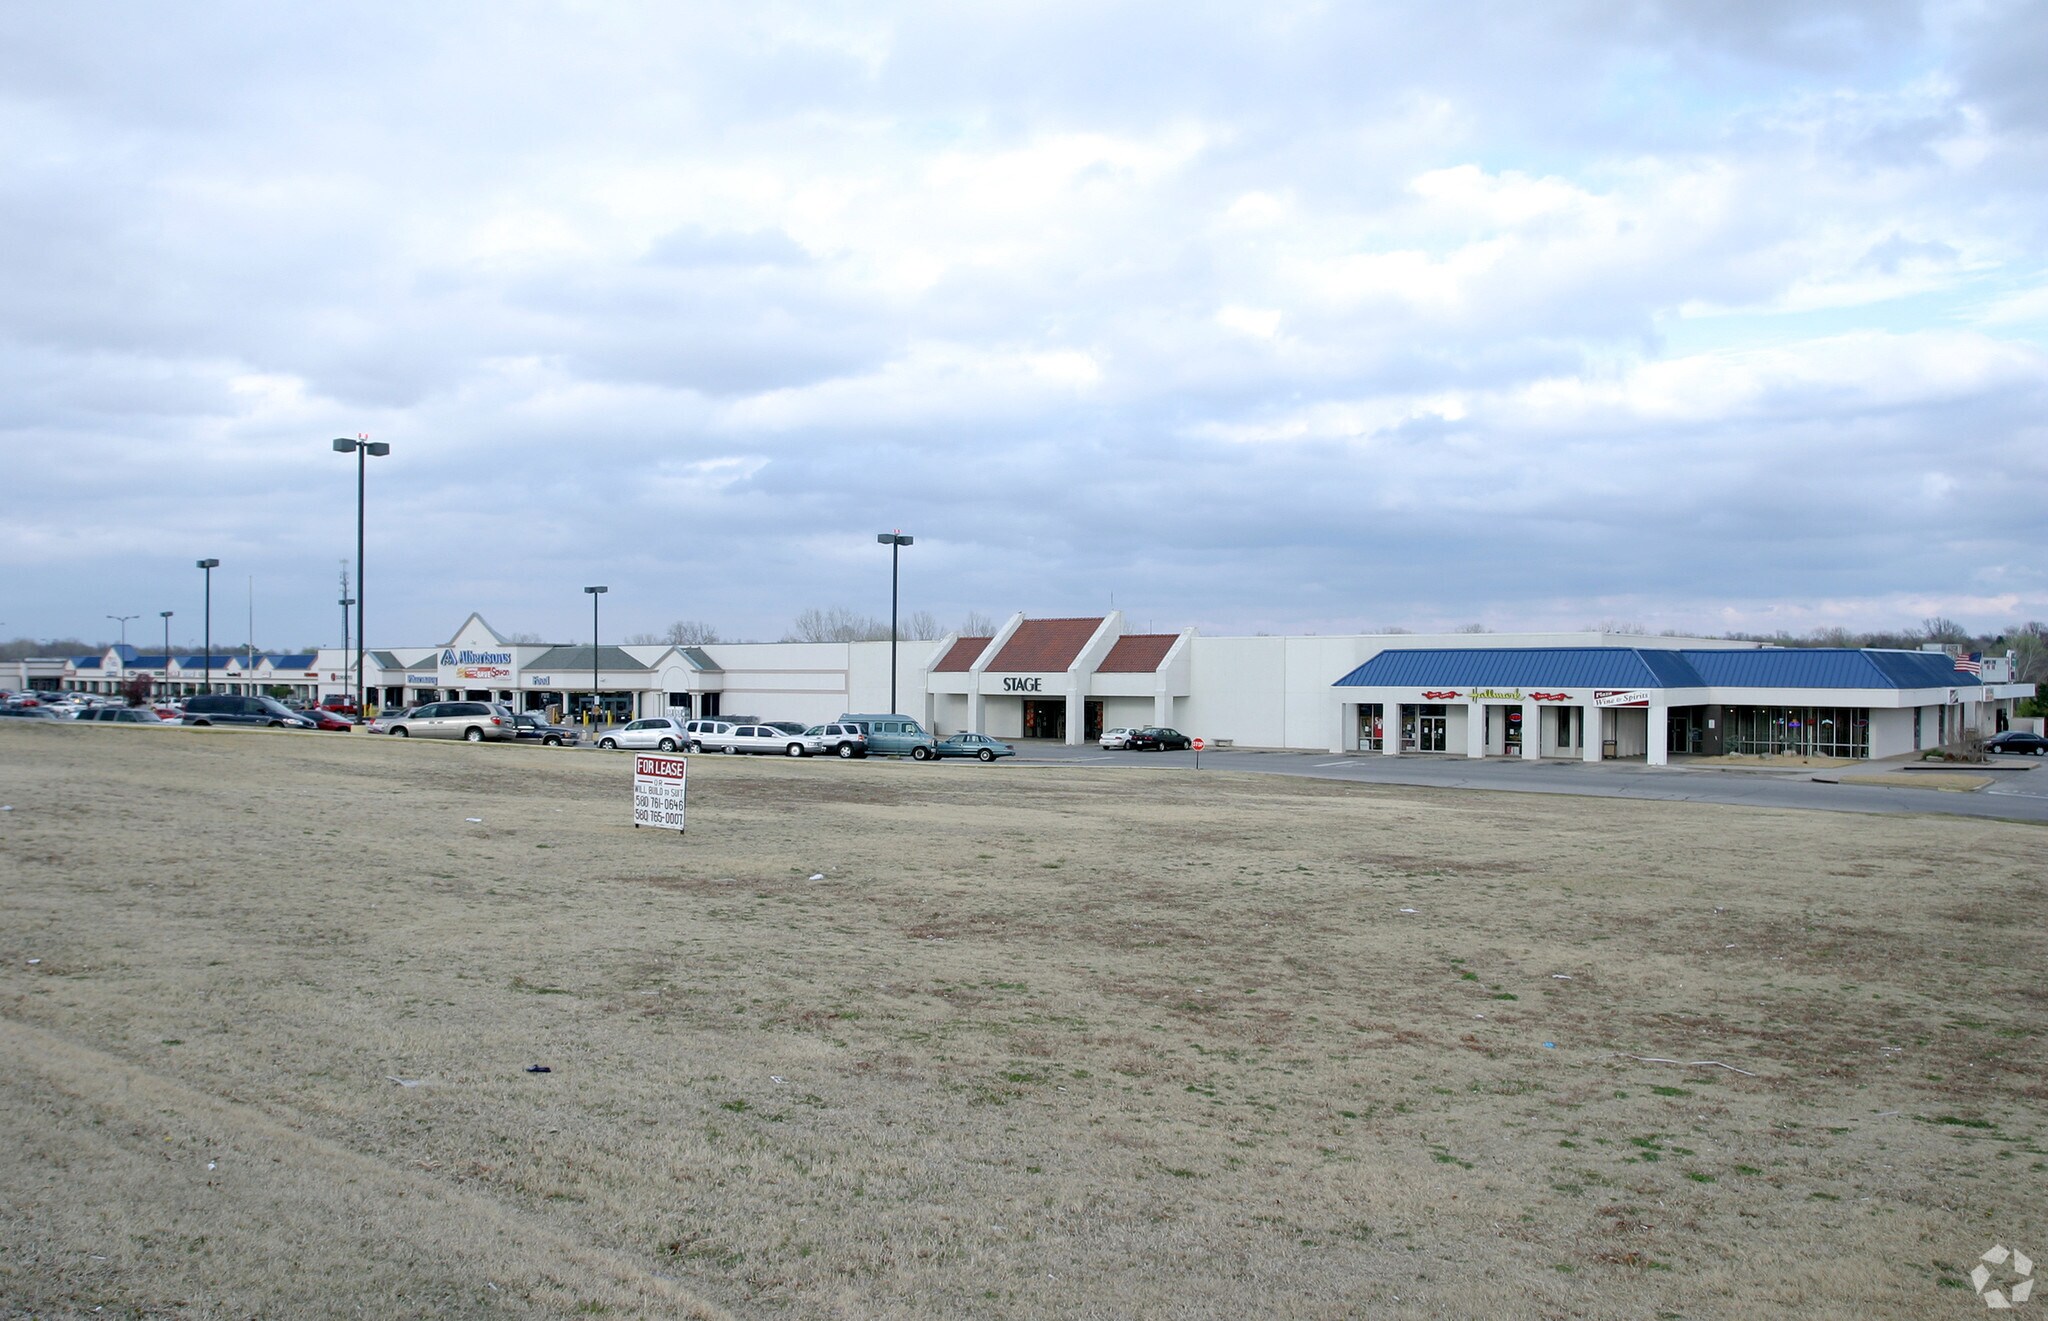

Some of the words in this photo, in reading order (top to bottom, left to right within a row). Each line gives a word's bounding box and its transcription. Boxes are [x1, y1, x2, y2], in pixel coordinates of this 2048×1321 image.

[459, 650, 511, 664] Albertsons
[533, 676, 550, 685] Food
[1003, 677, 1042, 691] STAGE
[1467, 687, 1526, 703] Hallmark
[1623, 693, 1648, 702] Spirits
[637, 759, 654, 773] FOR
[655, 761, 683, 777] LEASE
[635, 785, 647, 794] WILL
[648, 786, 663, 796] BUILD
[670, 789, 683, 797] SUIT
[635, 795, 649, 808] 580
[650, 797, 683, 811] 761-0646
[635, 808, 649, 822] 580
[649, 810, 683, 825] 765-0007
